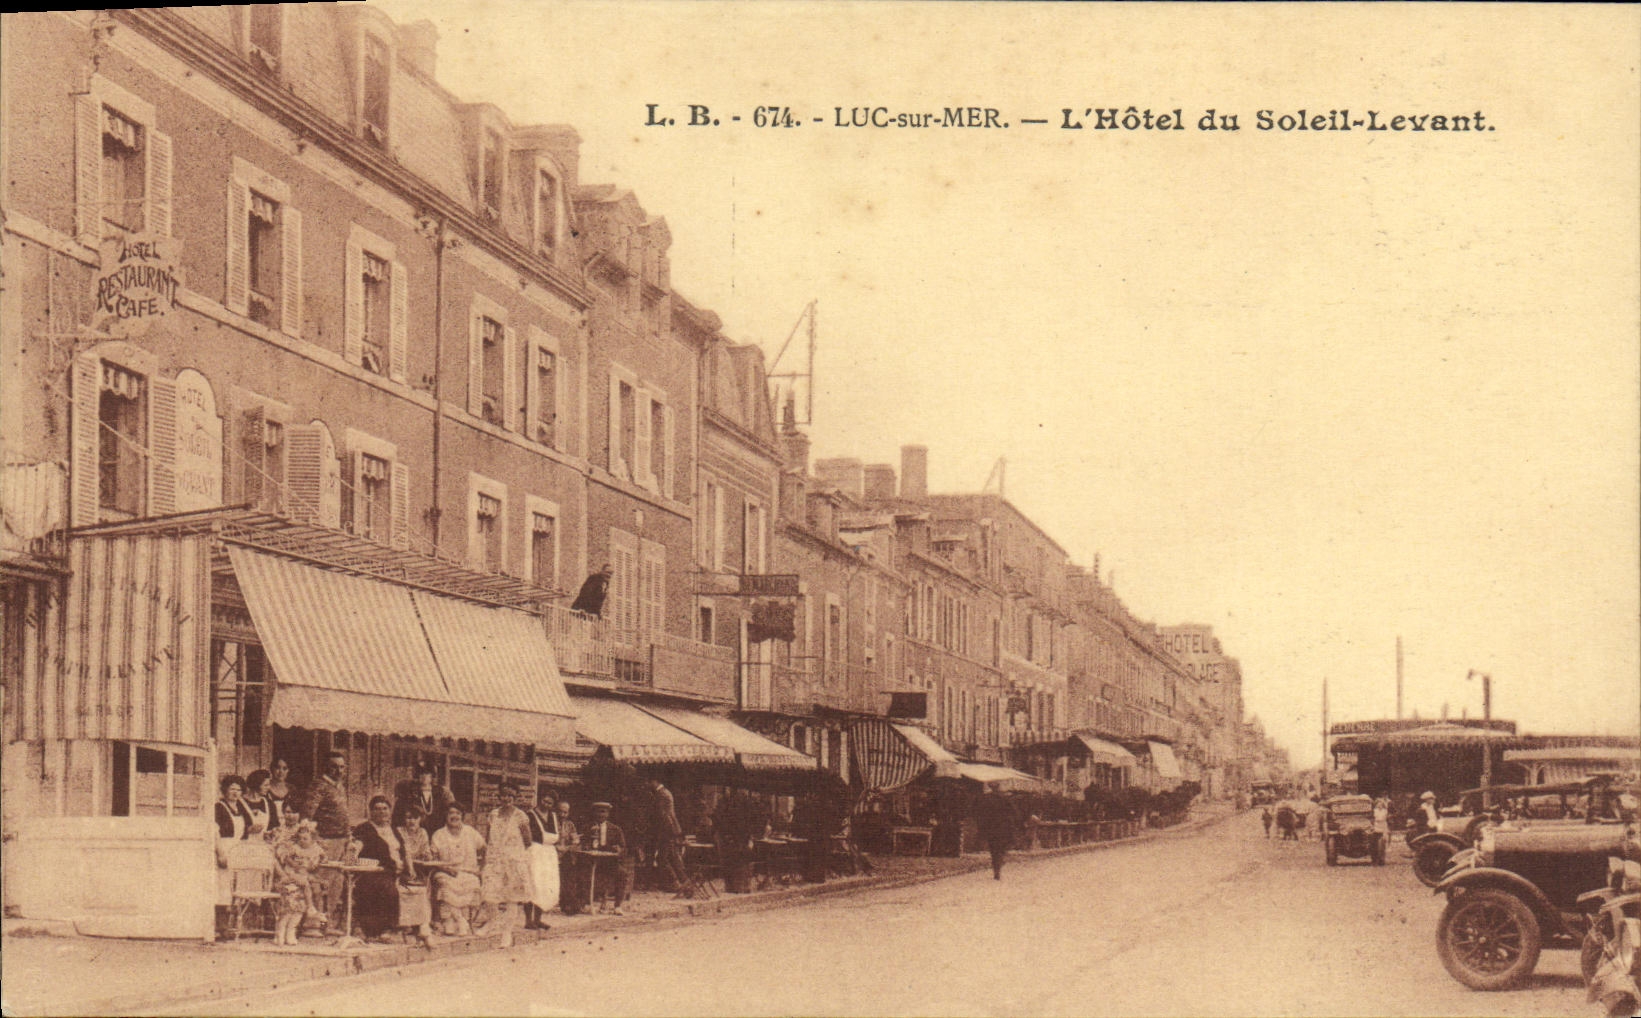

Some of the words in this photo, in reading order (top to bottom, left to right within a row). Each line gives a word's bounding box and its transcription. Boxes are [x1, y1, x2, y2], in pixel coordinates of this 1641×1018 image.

[118, 241, 161, 263] HOTEL
[97, 264, 180, 313] RESTAURANT
[1165, 633, 1209, 654] HOTEL
